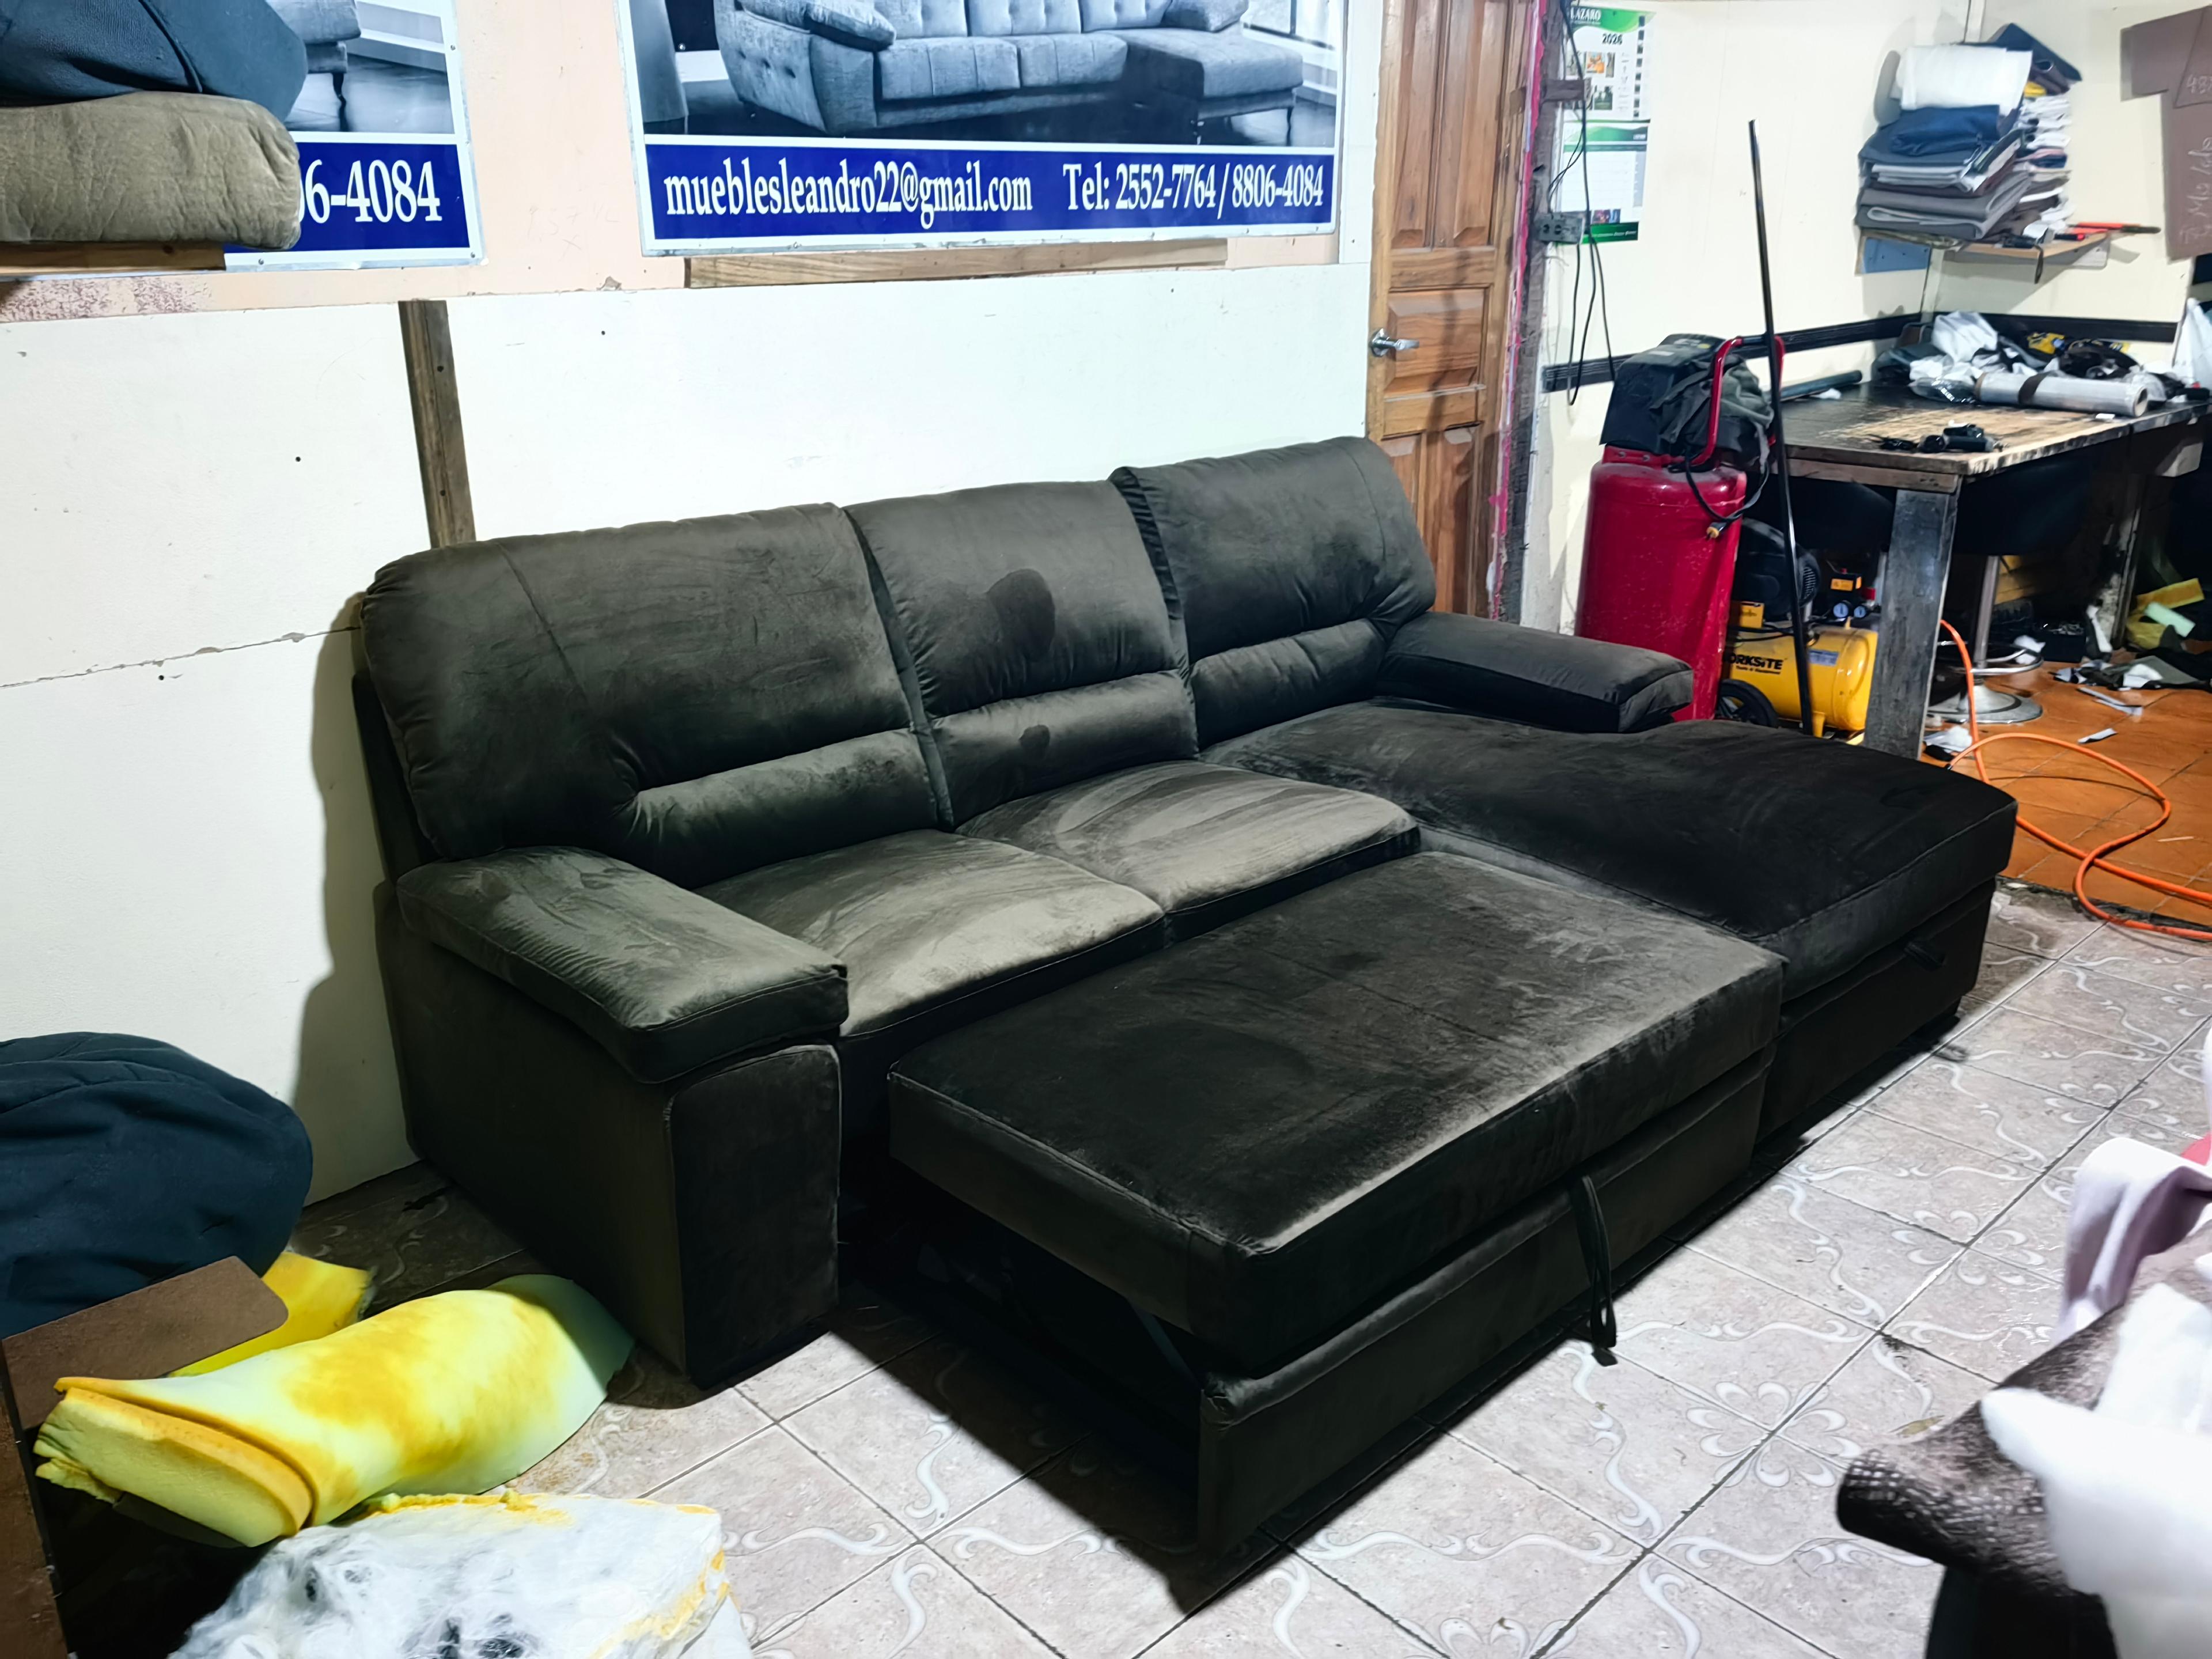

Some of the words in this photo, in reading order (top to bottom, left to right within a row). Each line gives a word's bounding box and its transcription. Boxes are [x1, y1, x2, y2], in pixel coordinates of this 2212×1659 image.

[663, 157, 1033, 230] mueblesleandro22@gmail.com
[1063, 161, 1110, 211] Tel:
[1115, 163, 1217, 210] 2552-7764
[1217, 162, 1230, 220] /
[1232, 164, 1324, 209] 8806-4084
